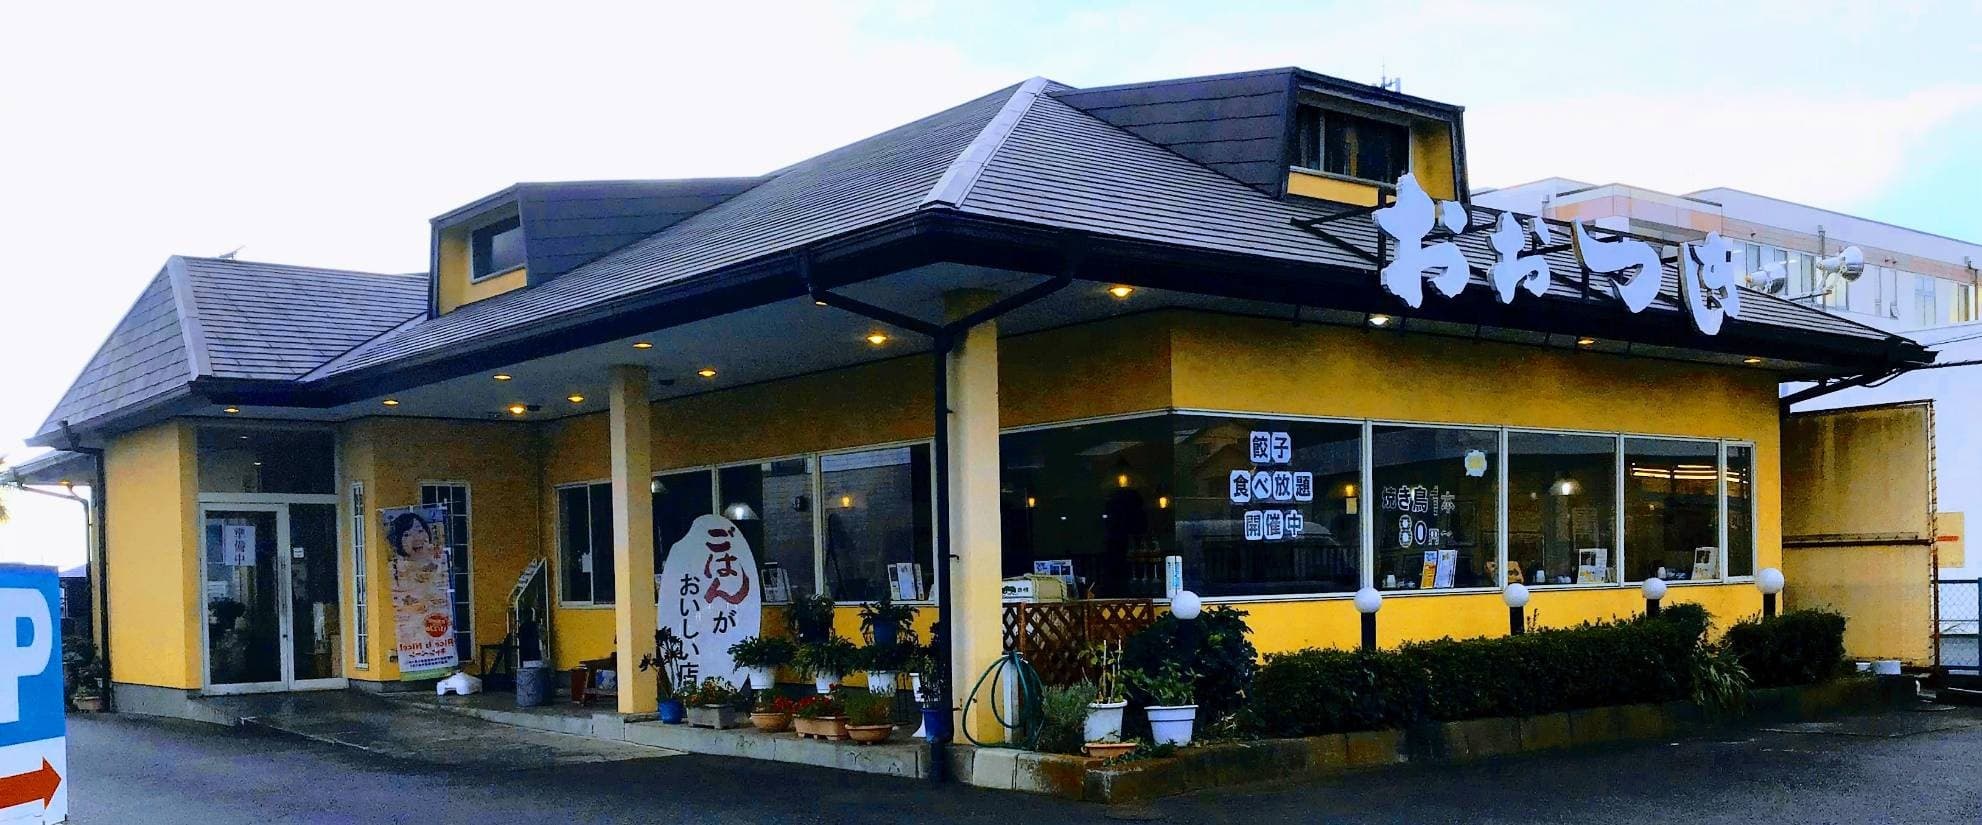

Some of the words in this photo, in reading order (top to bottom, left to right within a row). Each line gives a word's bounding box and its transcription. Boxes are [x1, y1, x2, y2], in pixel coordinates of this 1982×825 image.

[1251, 434, 1290, 461] 餃子
[1232, 472, 1312, 499] 食べ放題
[1245, 511, 1302, 538] 開催中
[0, 587, 53, 724] P
